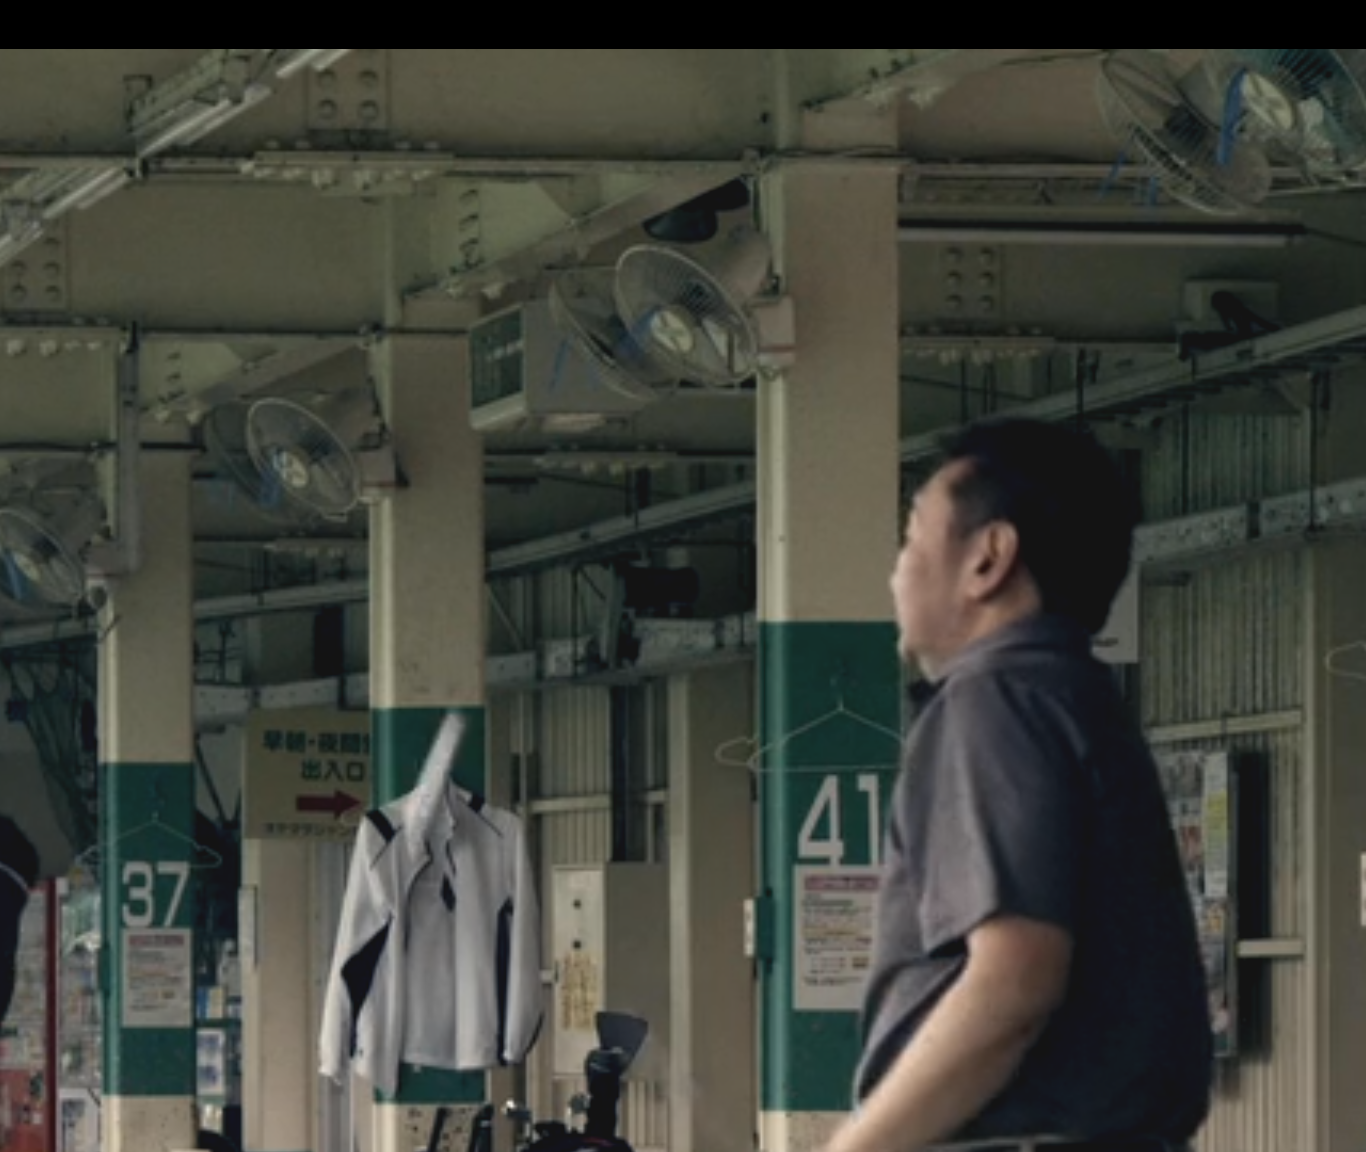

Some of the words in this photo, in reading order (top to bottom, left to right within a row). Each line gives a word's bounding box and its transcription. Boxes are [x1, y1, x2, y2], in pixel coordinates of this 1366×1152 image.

[301, 760, 364, 782] 出入口
[797, 774, 883, 865] 41
[121, 861, 191, 927] 37
